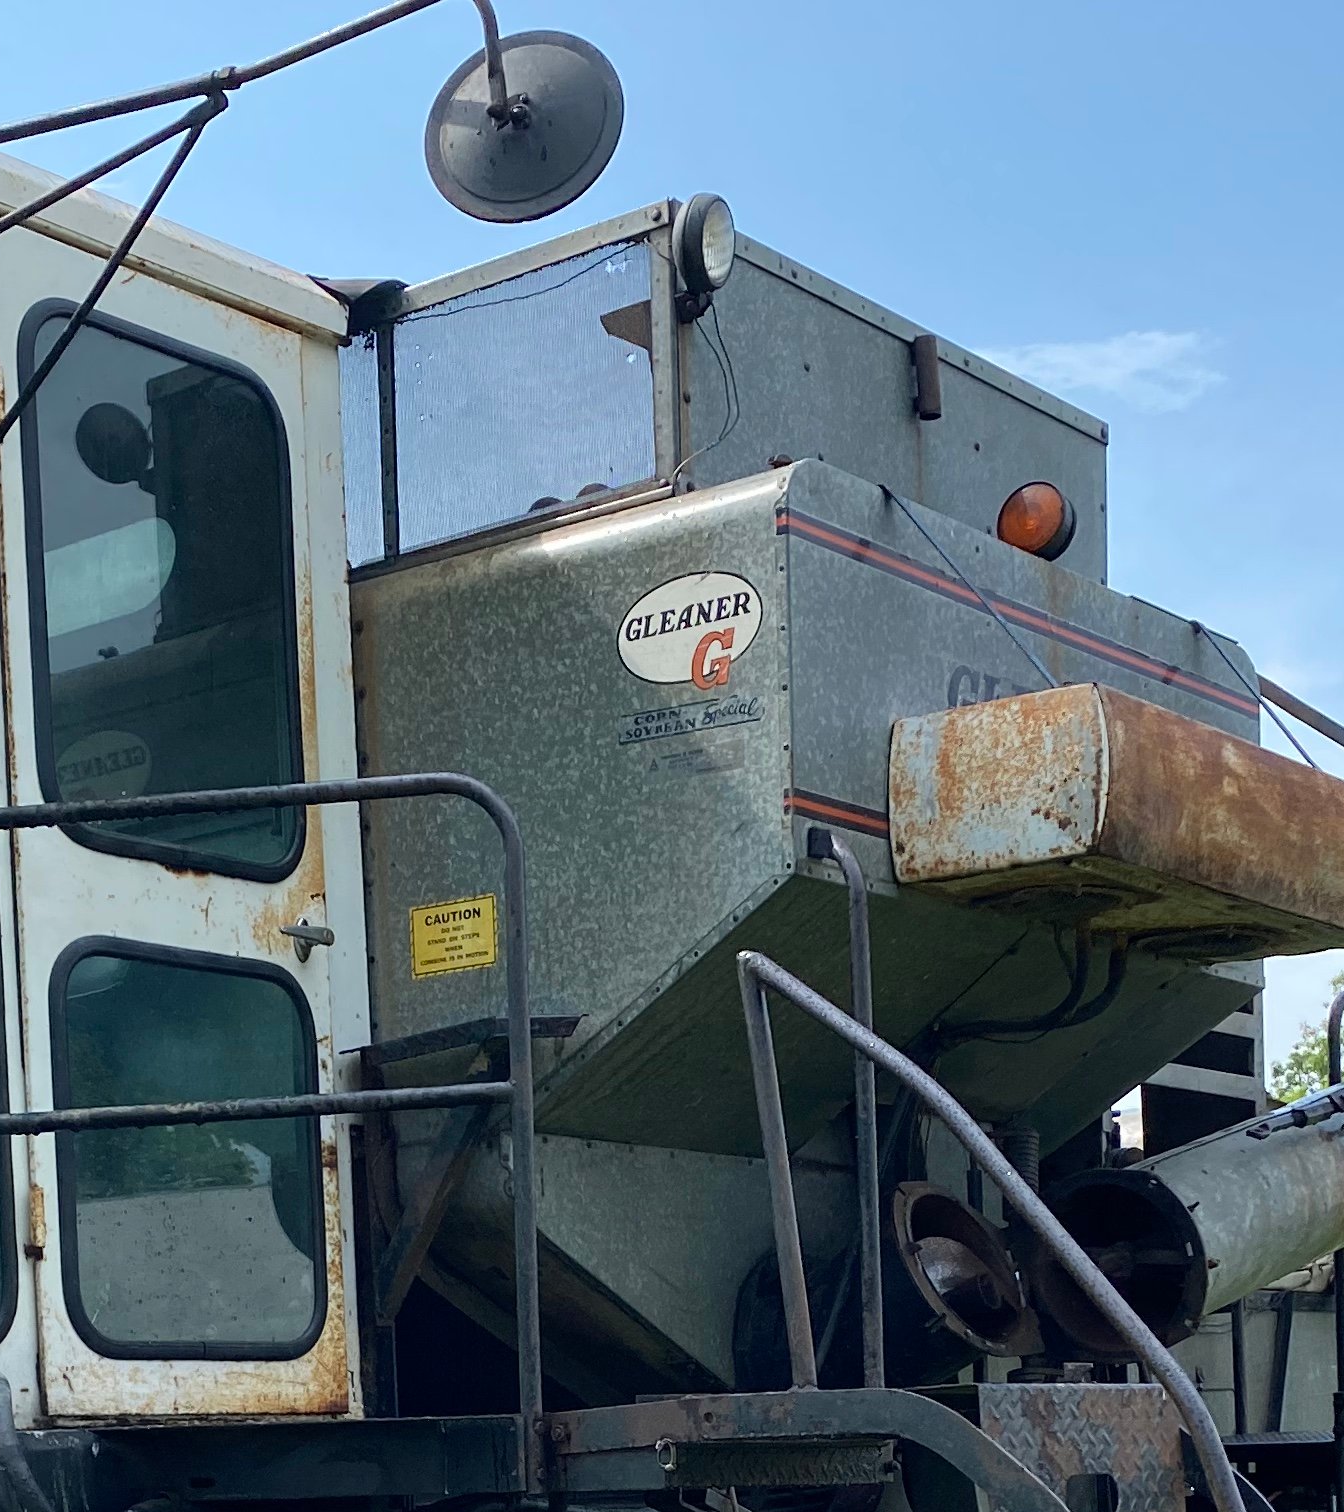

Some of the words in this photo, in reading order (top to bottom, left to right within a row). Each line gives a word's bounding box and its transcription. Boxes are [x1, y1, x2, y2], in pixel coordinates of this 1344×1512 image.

[625, 591, 751, 642] GLEANER
[691, 627, 736, 690] G
[625, 717, 696, 740] SOYBEAN
[425, 907, 480, 926] CAUTION
